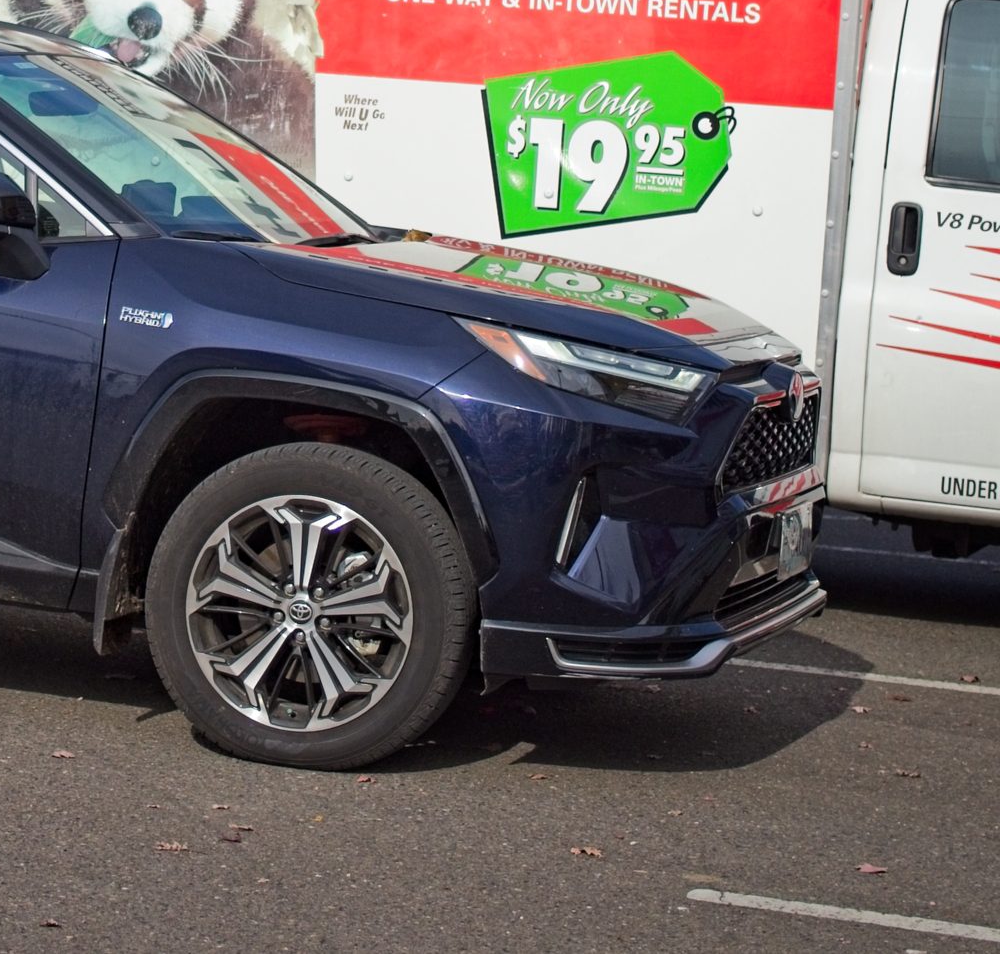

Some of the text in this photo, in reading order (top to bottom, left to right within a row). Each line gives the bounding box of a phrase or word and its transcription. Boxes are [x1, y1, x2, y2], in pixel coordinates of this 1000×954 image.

[344, 93, 379, 106] Where
[511, 78, 656, 129] Now Only
[334, 106, 356, 118] Will
[358, 107, 369, 121] U
[635, 174, 683, 186] IN-TOWN
[936, 211, 964, 229] V8
[119, 313, 160, 327] HYBRID
[940, 475, 998, 500] UNDER
